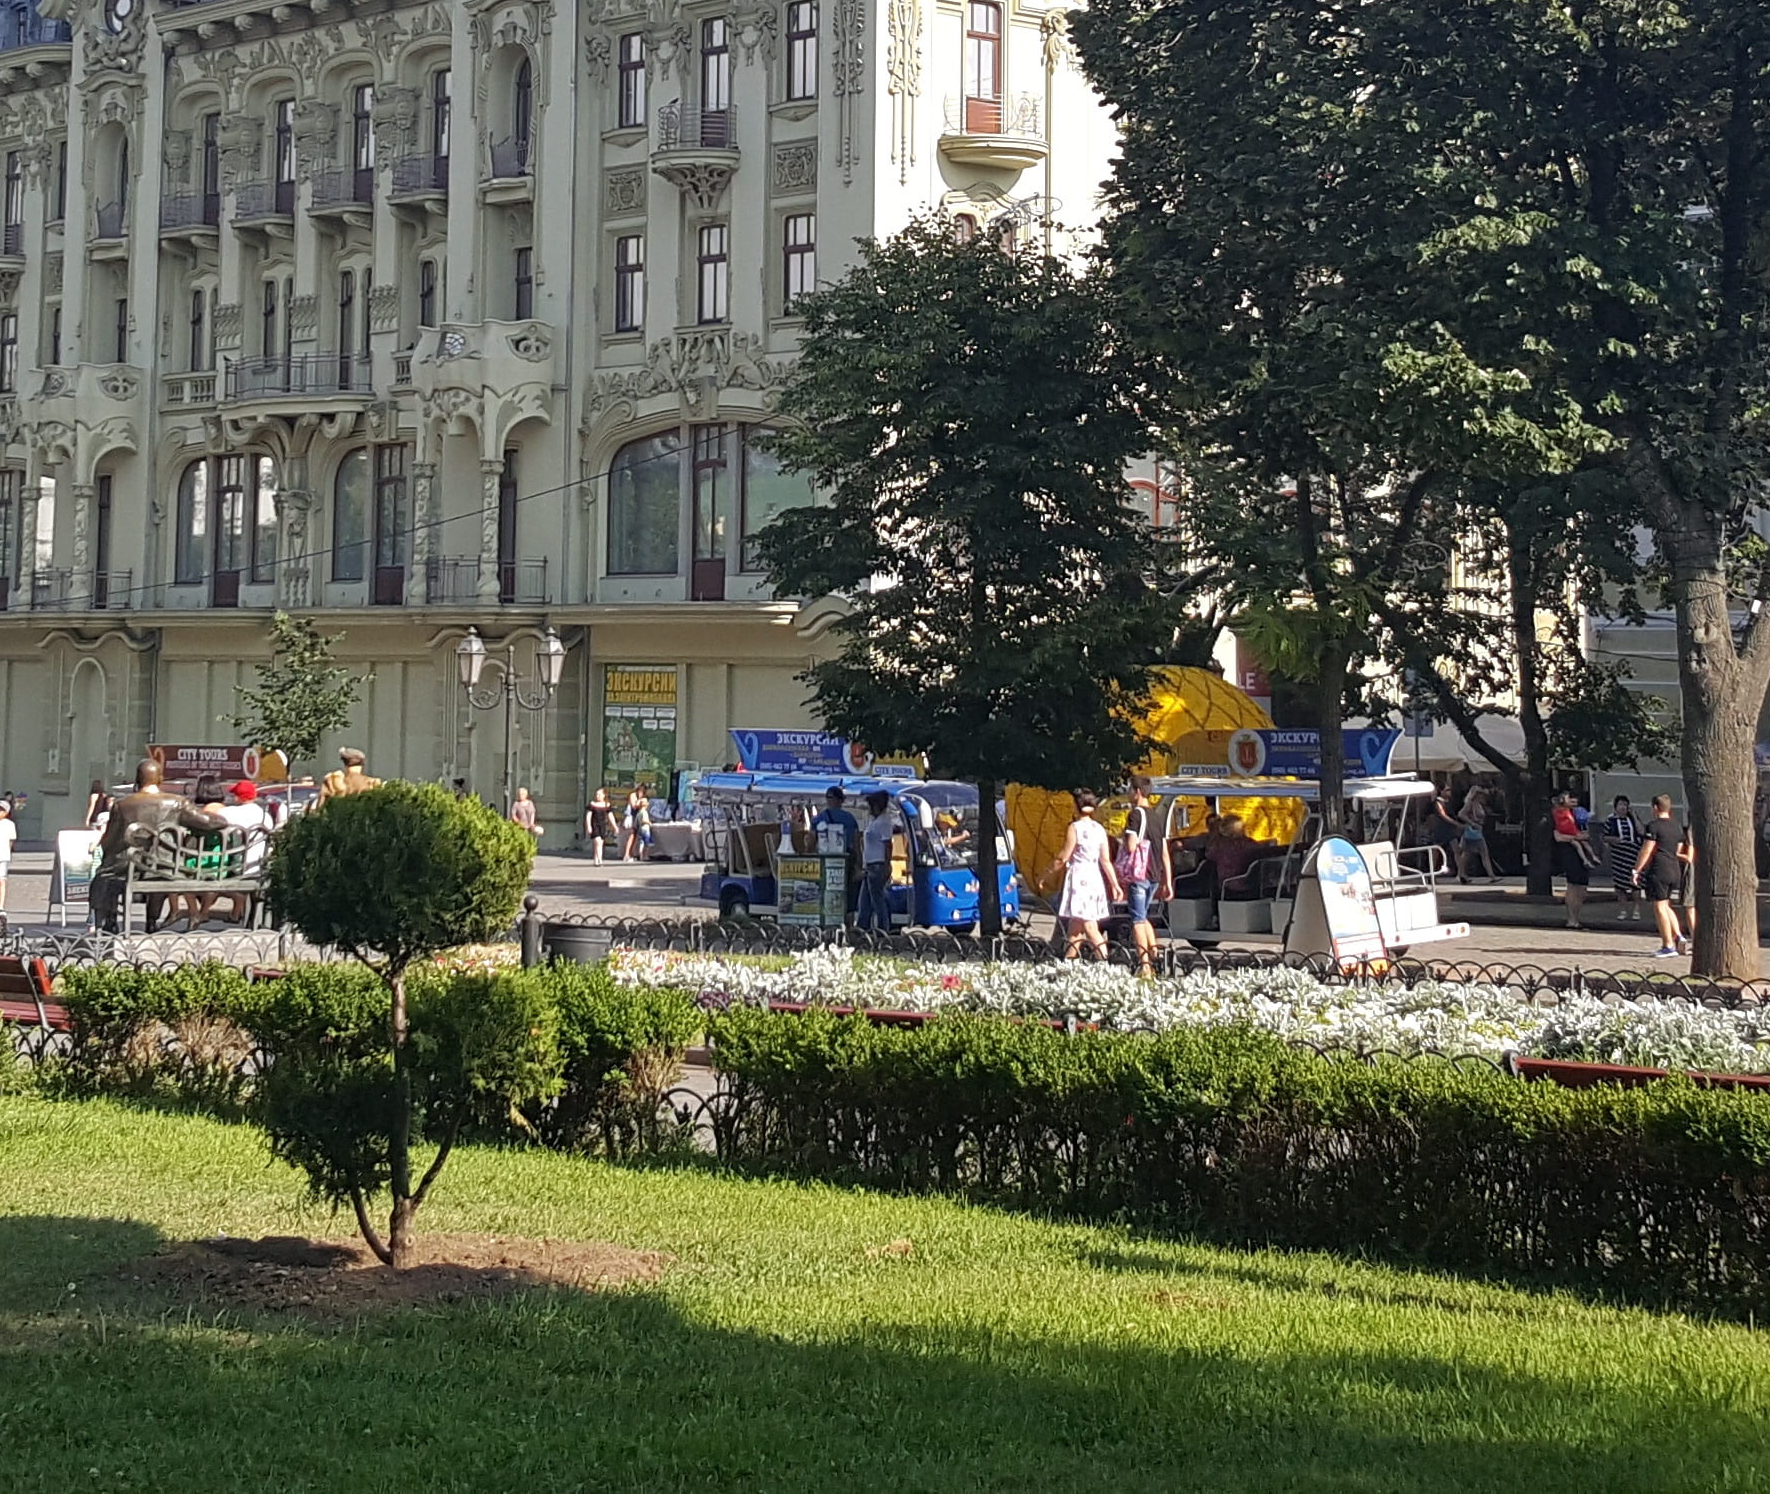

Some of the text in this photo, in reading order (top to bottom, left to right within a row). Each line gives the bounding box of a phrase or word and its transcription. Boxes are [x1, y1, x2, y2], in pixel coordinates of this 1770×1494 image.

[606, 672, 676, 692] ЭКСКУРСИИ
[178, 748, 228, 761] CITY TOURS
[875, 766, 889, 774] CITY
[1181, 766, 1227, 775] CITY TOURS
